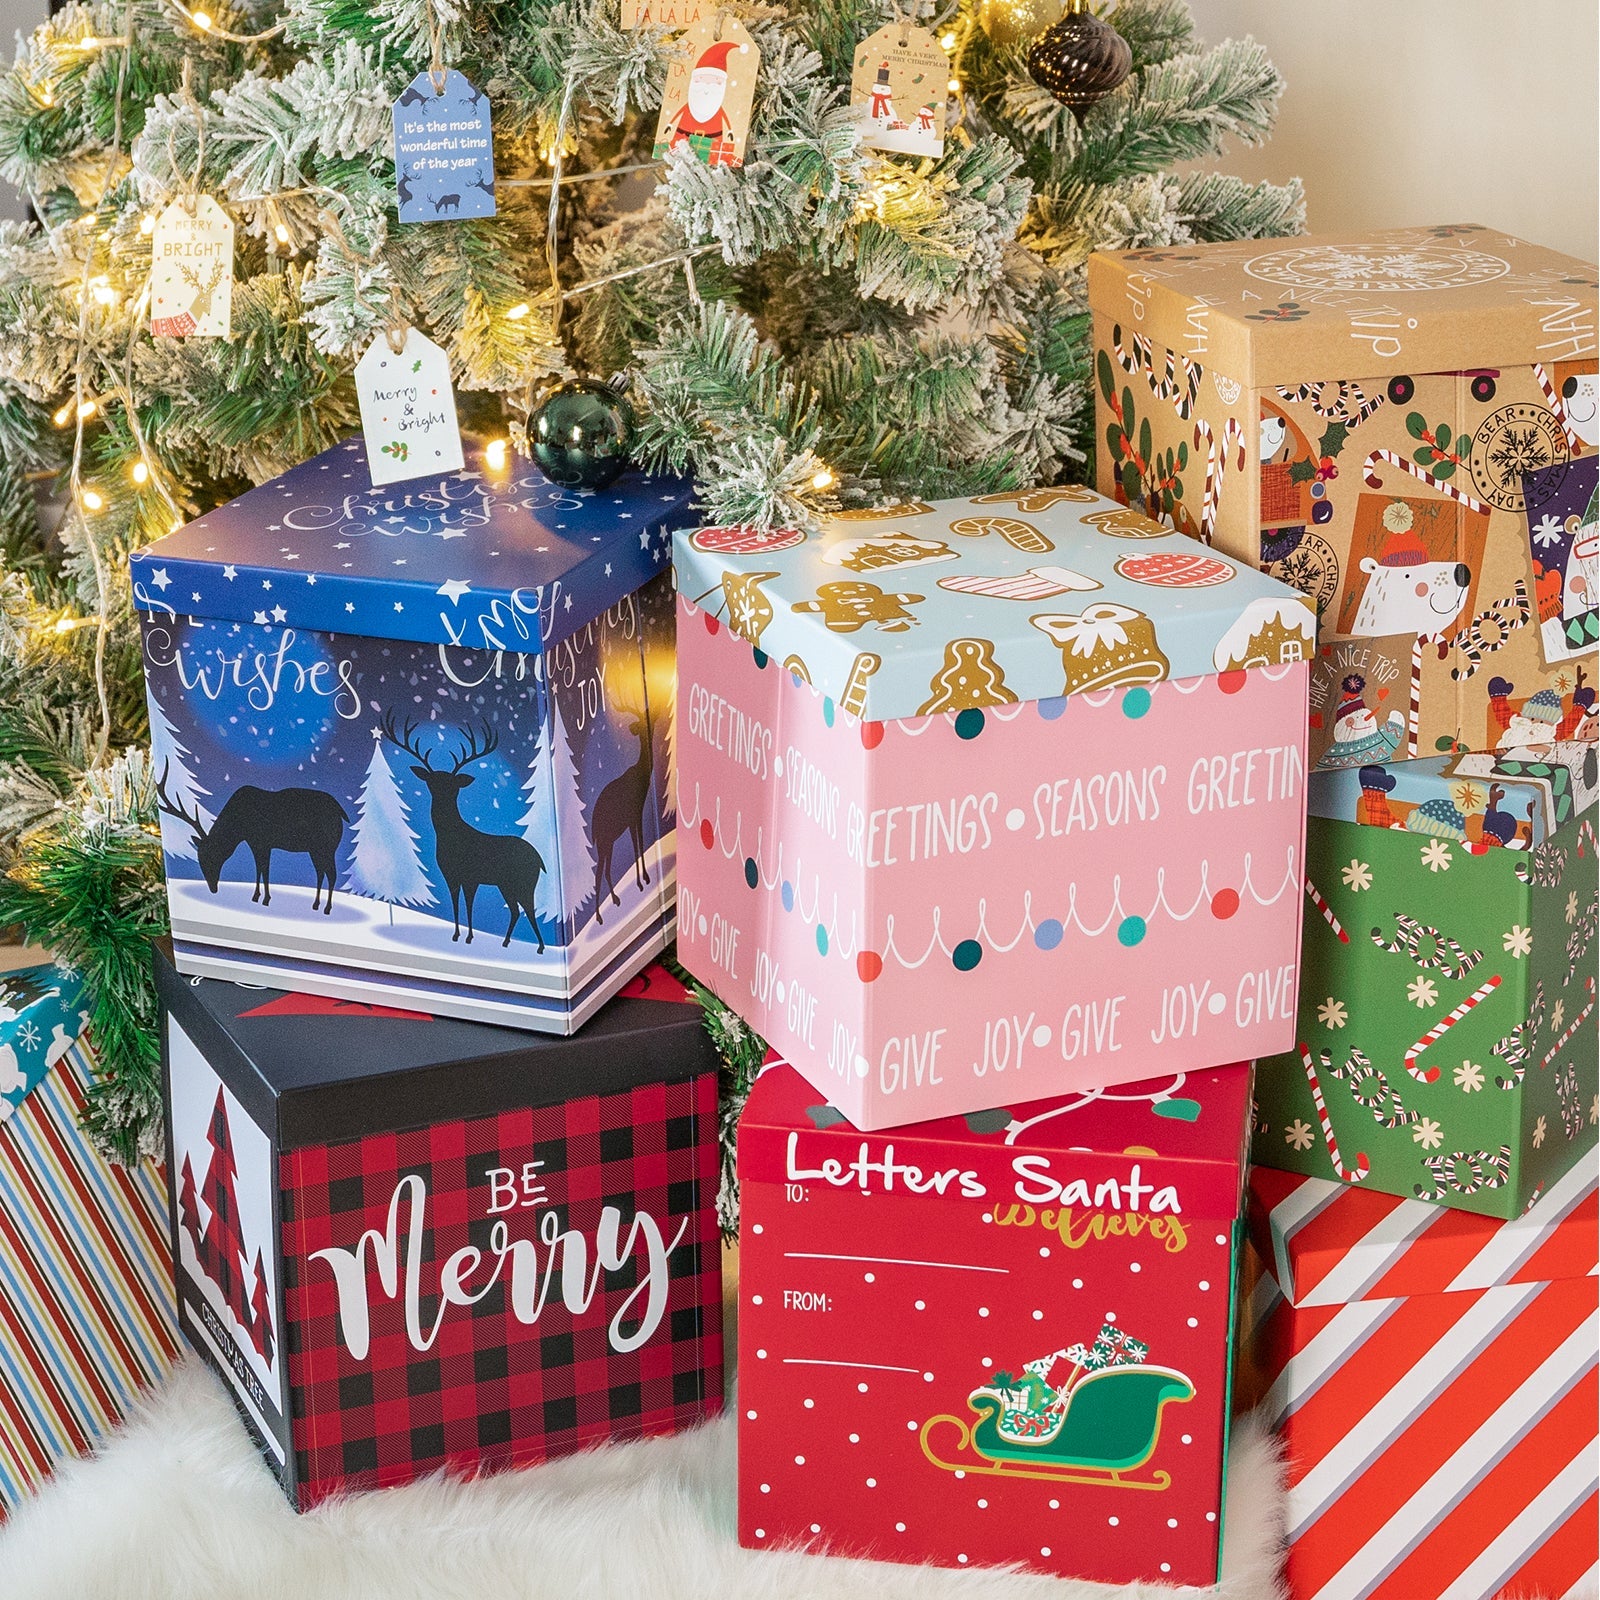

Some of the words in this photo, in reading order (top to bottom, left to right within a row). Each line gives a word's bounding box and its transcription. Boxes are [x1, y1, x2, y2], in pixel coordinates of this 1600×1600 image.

[660, 7, 677, 24] LA
[684, 7, 701, 24] LA
[892, 49, 911, 57] HAVE
[907, 58, 947, 68] CHRISTMAS
[674, 64, 687, 77] LA
[668, 87, 681, 101] LA
[403, 121, 425, 134] It's
[426, 120, 447, 132] the
[449, 119, 482, 131] most
[400, 137, 458, 152] wonderful
[459, 137, 488, 148] time
[412, 157, 427, 170] of
[428, 157, 449, 169] the
[450, 158, 478, 171] year
[175, 219, 213, 231] MERRY
[163, 242, 223, 257] BRIGHT
[373, 387, 417, 403] Merry
[403, 403, 414, 416] &
[1477, 407, 1517, 445] BEAR
[1536, 411, 1568, 498] CHRISTMAS
[283, 476, 554, 531] Christma
[1486, 488, 1515, 509] DAY
[146, 628, 362, 720] wishes
[1309, 673, 1329, 709] HAVE
[1323, 661, 1338, 678] A
[577, 662, 607, 731] JOY
[688, 683, 772, 781] GREETINGS
[786, 745, 840, 840] SEASONS
[847, 791, 998, 868] GREETINGS
[1033, 764, 1167, 841] SEASONS
[710, 912, 741, 980] GIVE
[750, 948, 780, 1011] JOY
[787, 979, 819, 1051] GIVE
[827, 1018, 857, 1086] JOY
[879, 1027, 947, 1095] GIVE
[973, 1011, 1036, 1078] JOY
[1061, 995, 1127, 1061] GIVE
[1151, 979, 1211, 1044] JOY
[1235, 963, 1296, 1029] GIVE
[786, 1131, 987, 1198] Letters
[1011, 1155, 1182, 1214] Santa
[485, 1160, 549, 1214] BE
[784, 1183, 810, 1203] TO:
[307, 1174, 689, 1361] Merry
[783, 1290, 833, 1313] FROM:
[244, 1365, 265, 1412] TREE
